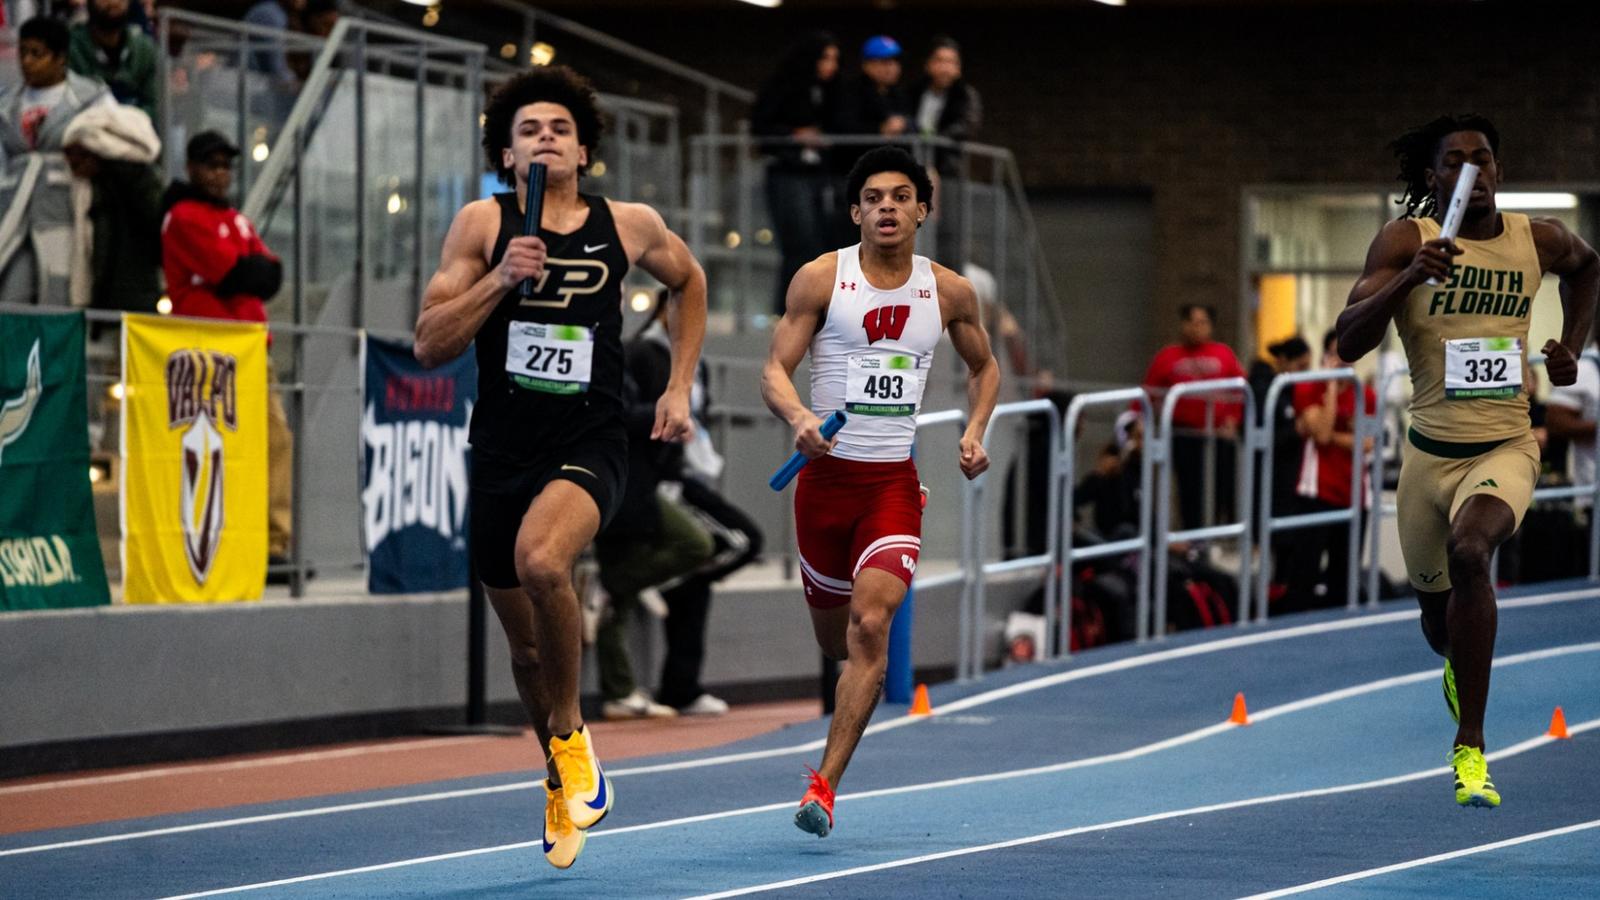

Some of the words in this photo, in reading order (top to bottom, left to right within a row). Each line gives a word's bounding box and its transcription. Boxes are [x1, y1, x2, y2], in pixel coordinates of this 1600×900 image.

[1445, 264, 1523, 293] SOUTH
[1429, 291, 1531, 319] FLORIDA
[862, 305, 911, 346] W
[526, 345, 573, 375] 275
[1465, 358, 1507, 383] 332
[166, 349, 238, 432] VALPO
[864, 375, 903, 399] 493
[363, 412, 471, 551] BISON
